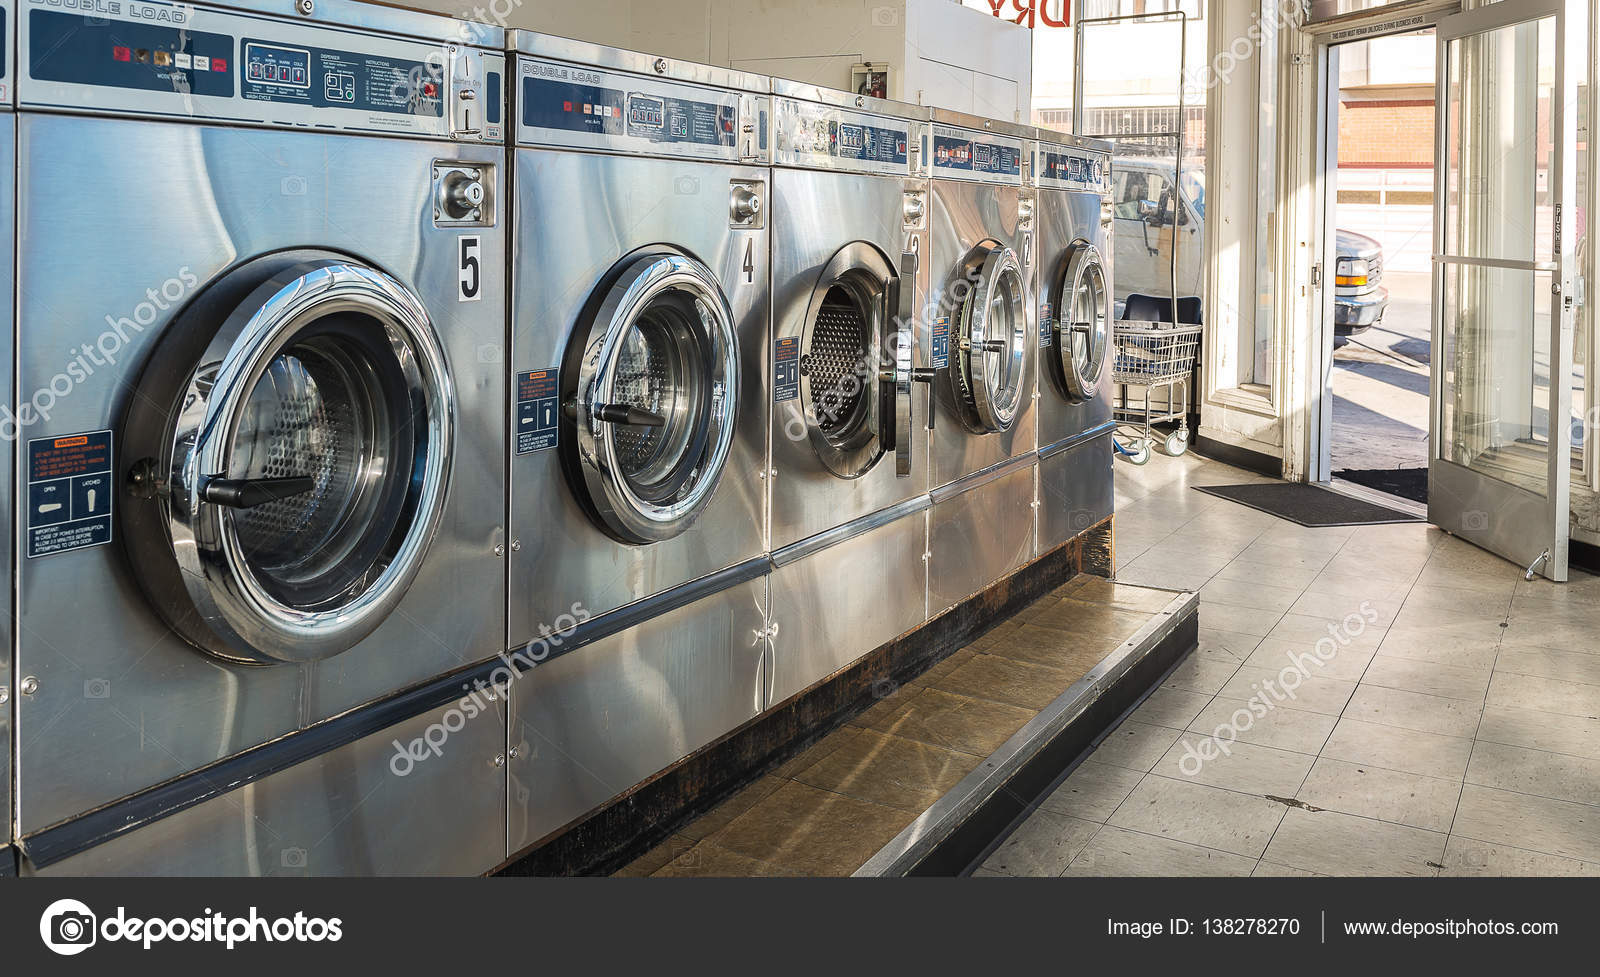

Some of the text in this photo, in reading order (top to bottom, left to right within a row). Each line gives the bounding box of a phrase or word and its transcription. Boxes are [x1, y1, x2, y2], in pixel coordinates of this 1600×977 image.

[29, 0, 186, 23] OUBLE LOAD
[522, 63, 601, 85] DOUBLE LOAD
[461, 238, 479, 298] 5
[742, 237, 754, 283] 4
[82, 478, 101, 486] LATCHED
[57, 535, 75, 544] MINUTES
[75, 532, 92, 540] BEFORE
[59, 529, 74, 537] POWER
[35, 544, 61, 552] ATTEMPTING
